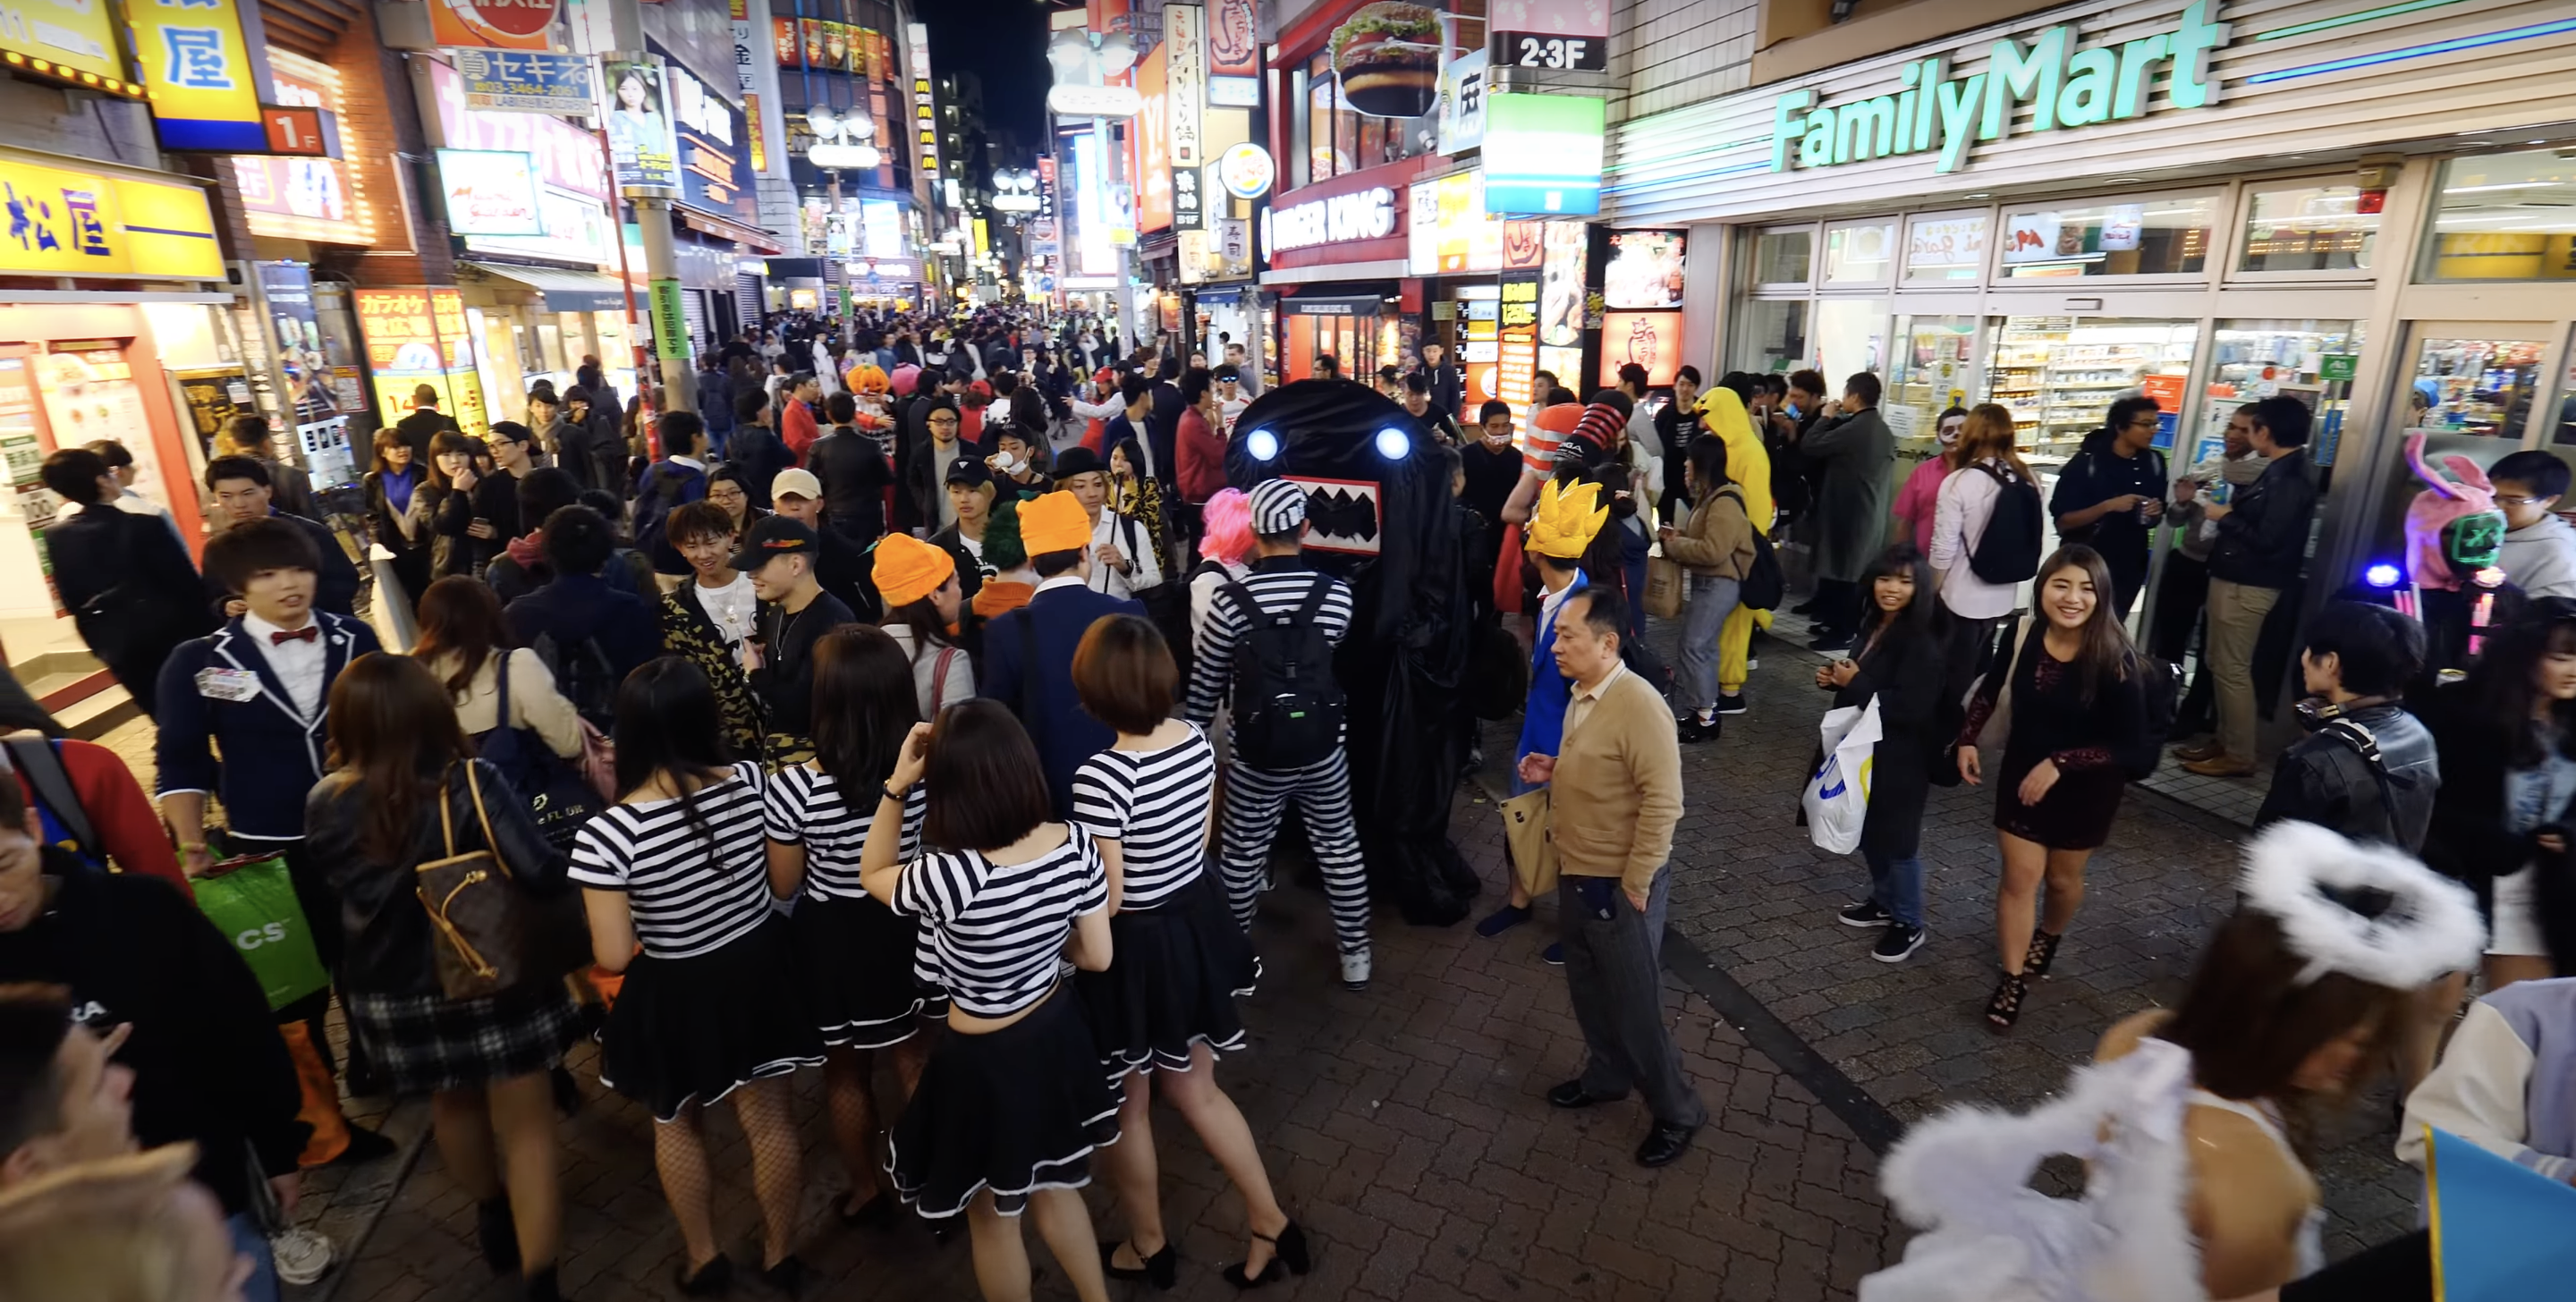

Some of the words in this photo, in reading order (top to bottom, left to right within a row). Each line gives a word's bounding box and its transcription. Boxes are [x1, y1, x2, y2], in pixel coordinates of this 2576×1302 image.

[162, 0, 232, 90] 屋
[490, 52, 588, 85] セキネ
[1771, 0, 2220, 173] FamilyMart
[6, 182, 112, 257] 松屋
[1327, 186, 1395, 241] KING
[359, 294, 428, 315] カラオケ
